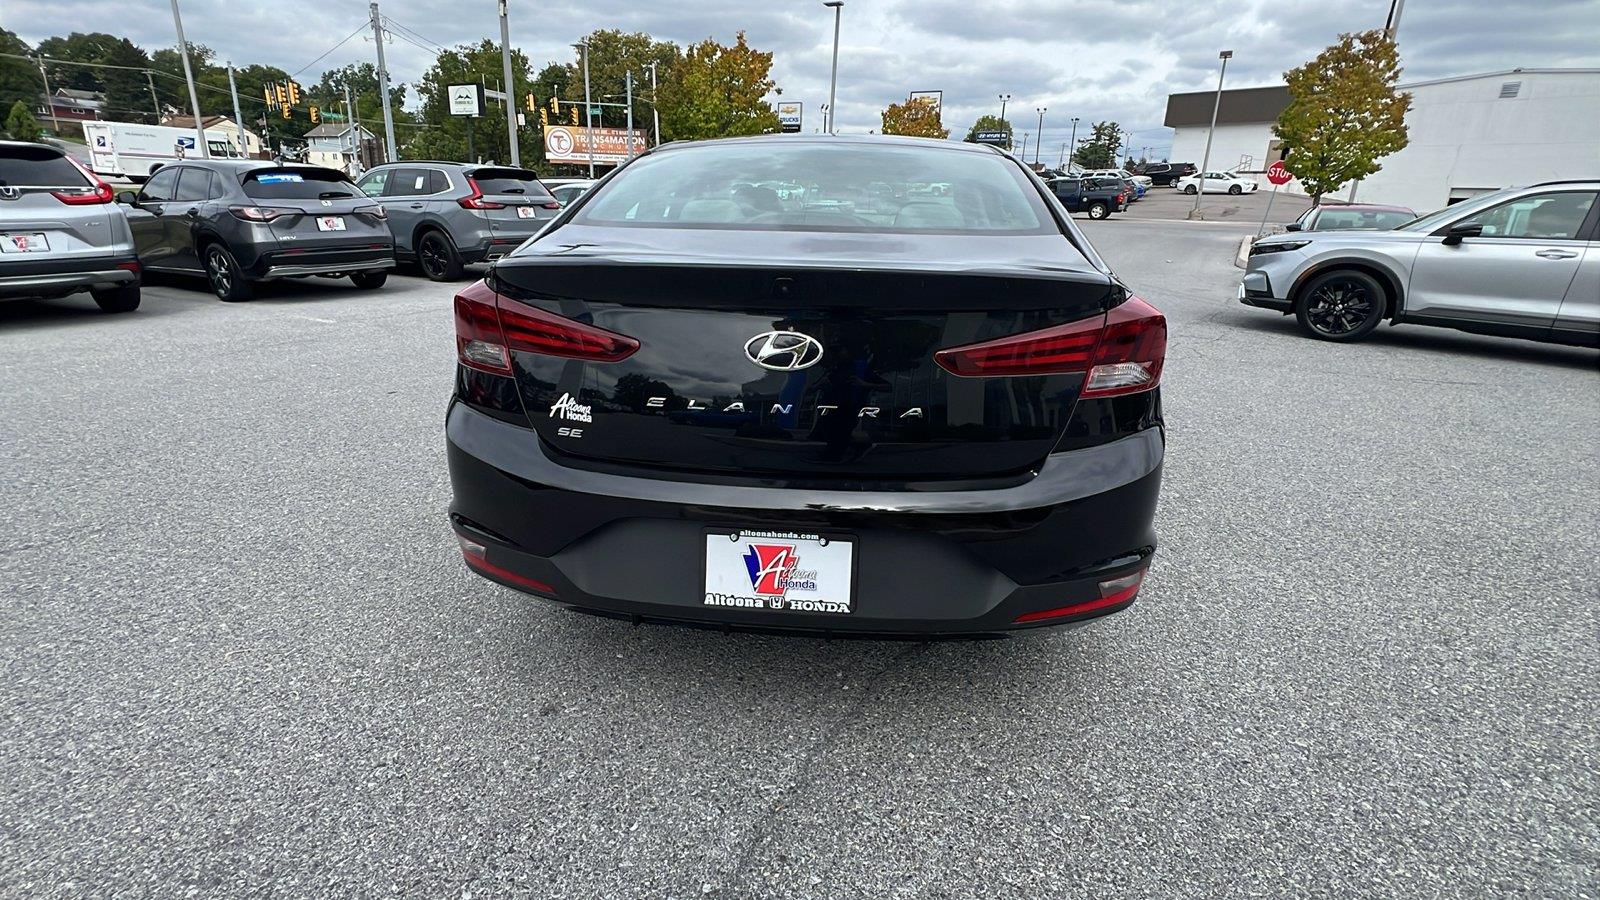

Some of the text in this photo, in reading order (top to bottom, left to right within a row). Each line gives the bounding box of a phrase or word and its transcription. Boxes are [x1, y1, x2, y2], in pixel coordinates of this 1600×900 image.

[575, 135, 645, 145] TRNS4MATON
[549, 392, 592, 419] Altoona
[646, 397, 923, 418] ELANTRA
[566, 410, 592, 423] Honda
[557, 427, 584, 438] SE
[739, 530, 819, 540] altoonahonda.com
[780, 579, 816, 590] Honda
[704, 593, 850, 613] Altoona HONDA
